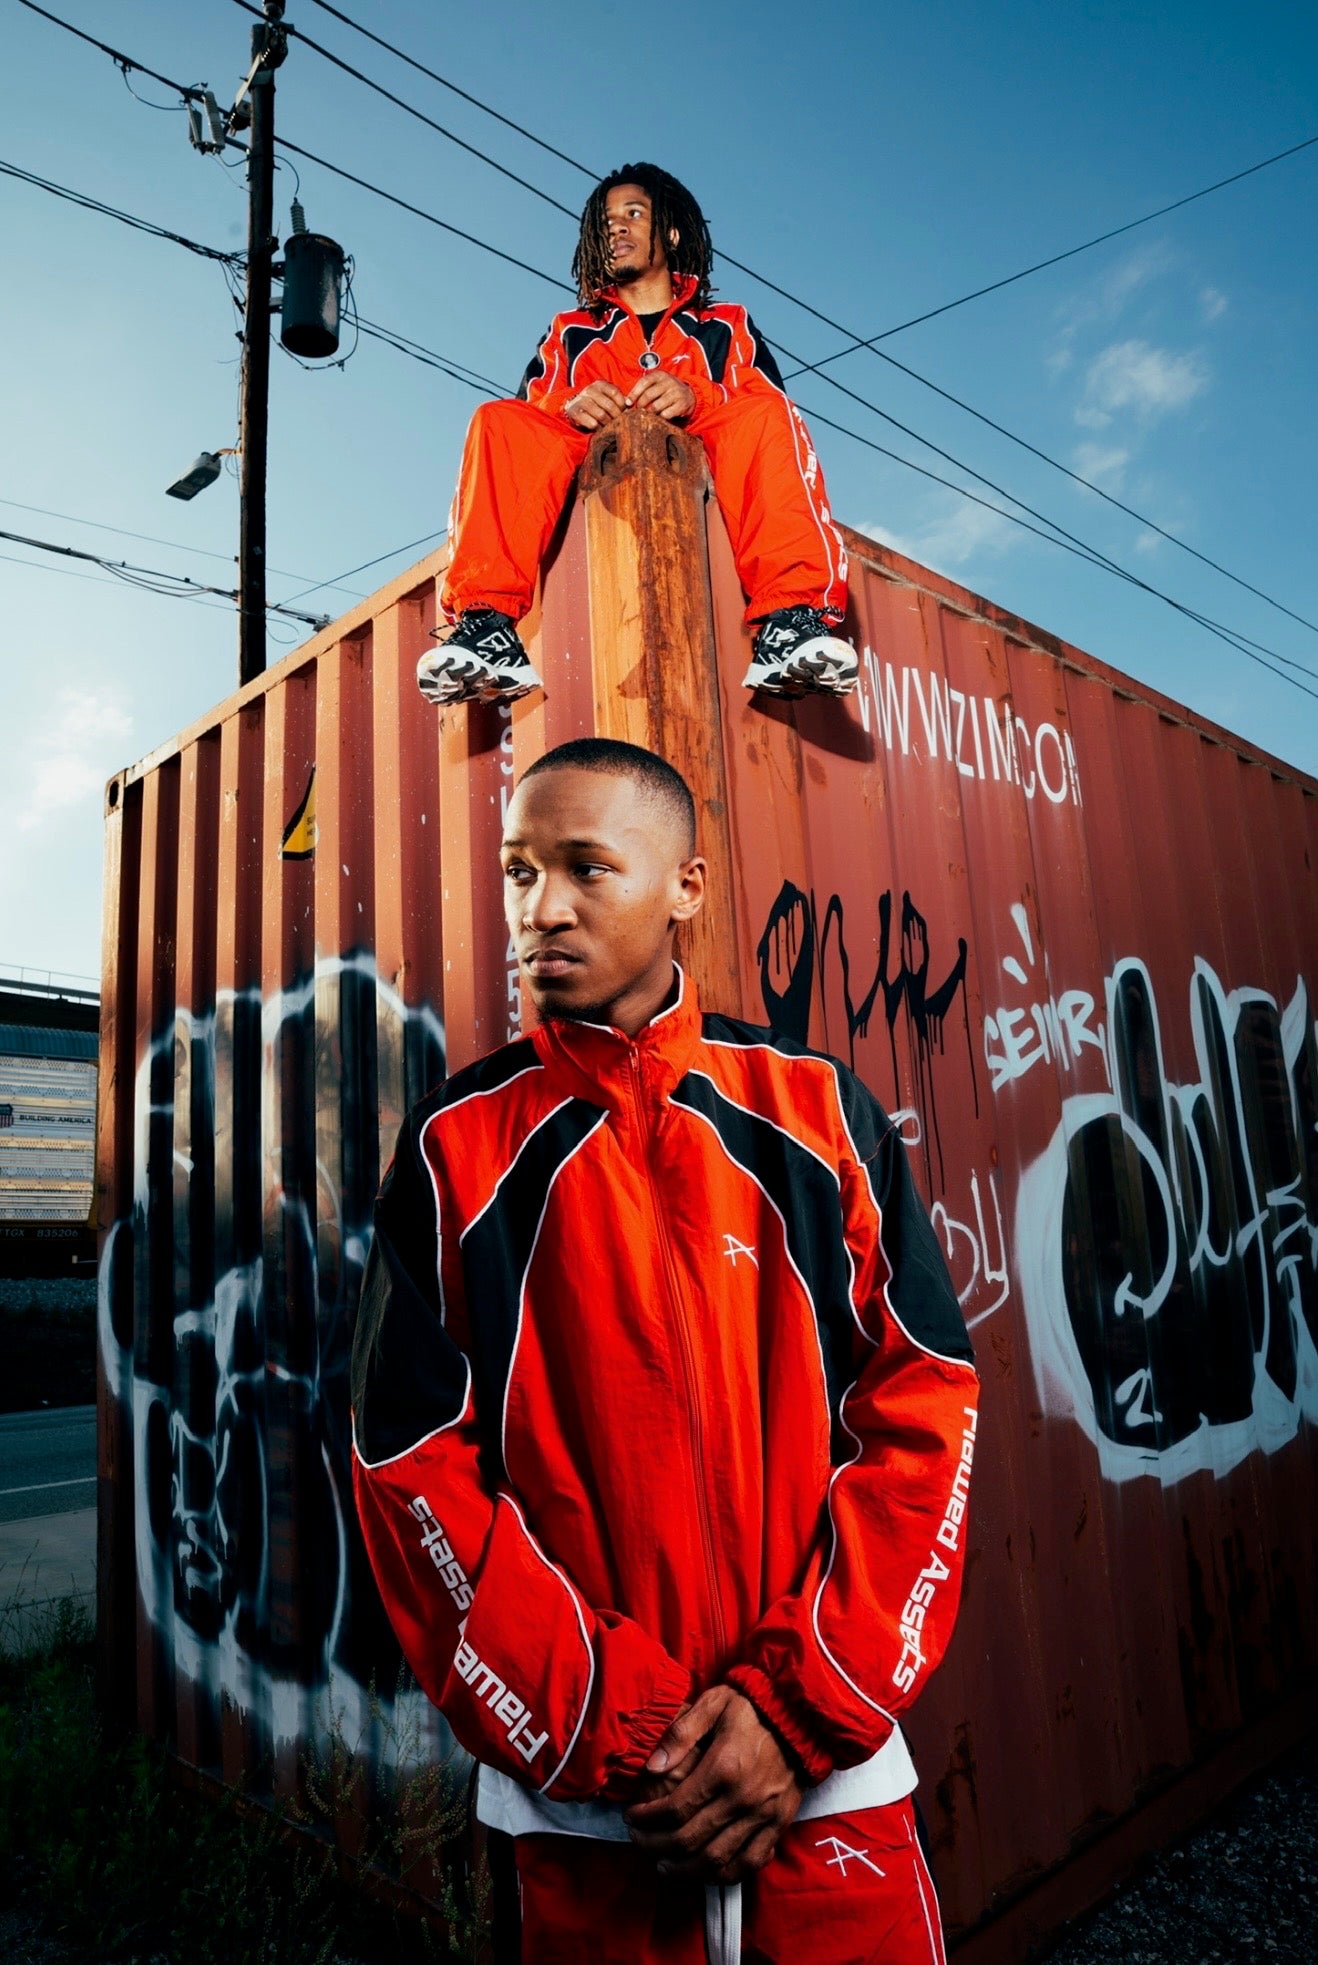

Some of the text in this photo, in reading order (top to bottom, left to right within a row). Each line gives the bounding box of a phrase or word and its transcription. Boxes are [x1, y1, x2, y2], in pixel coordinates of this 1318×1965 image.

[20, 1114, 56, 1122] BUILDING
[407, 1496, 550, 1763] Flawe ssets
[892, 1550, 951, 1694] Assets
